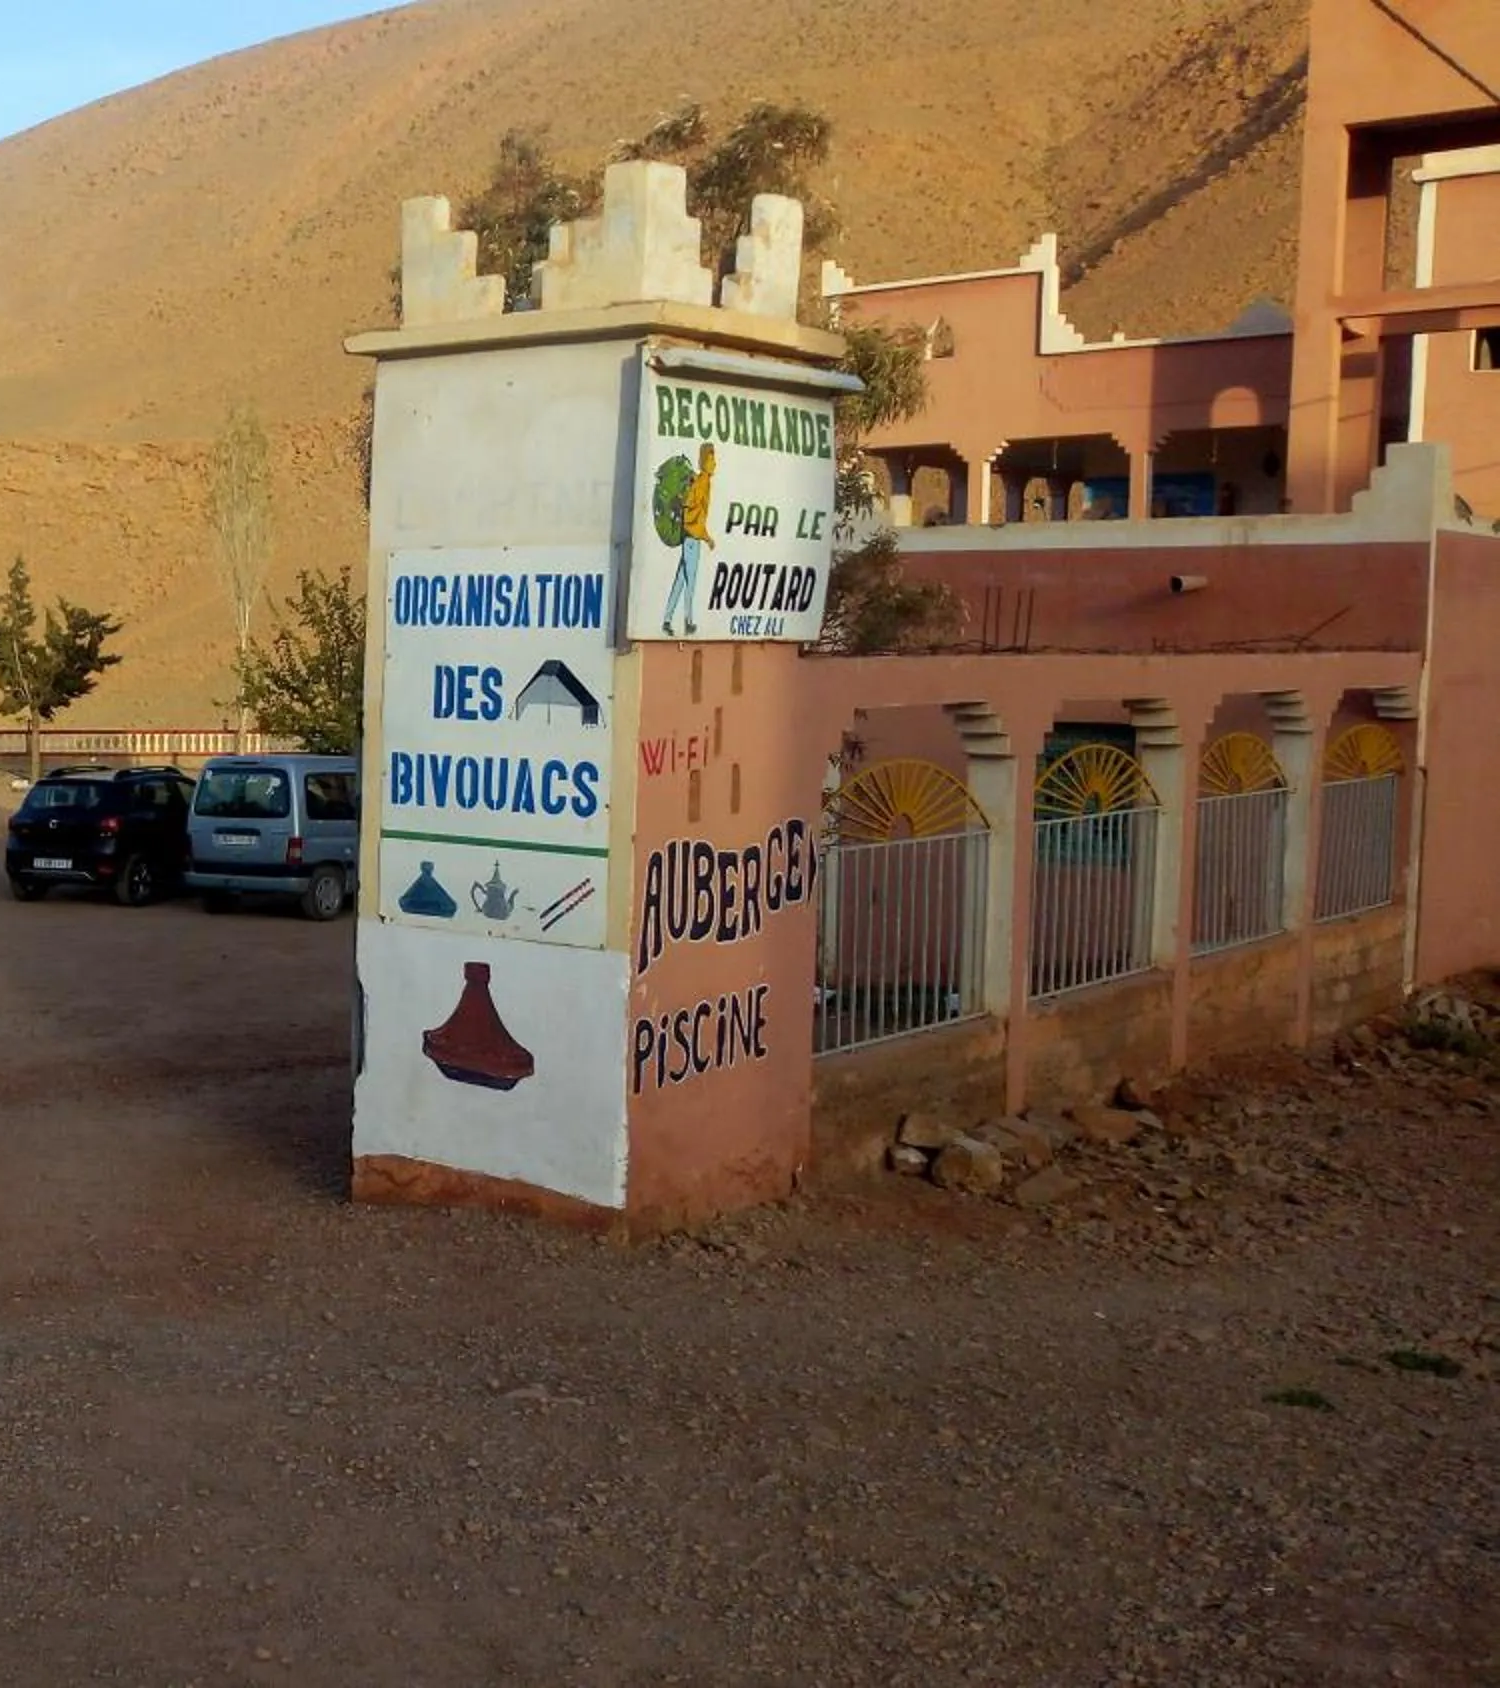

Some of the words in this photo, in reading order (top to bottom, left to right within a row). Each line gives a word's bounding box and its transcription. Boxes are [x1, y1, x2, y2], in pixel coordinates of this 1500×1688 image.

[656, 385, 831, 459] RECOMMANDE
[725, 502, 779, 537] PAR
[796, 508, 827, 540] LE
[395, 574, 604, 628] ORGANISATION
[708, 561, 816, 612] ROUTARD
[730, 615, 762, 636] CHEZ
[433, 665, 503, 721] DES
[391, 752, 599, 818] BIVOUACS
[638, 819, 805, 974] AUBERGE
